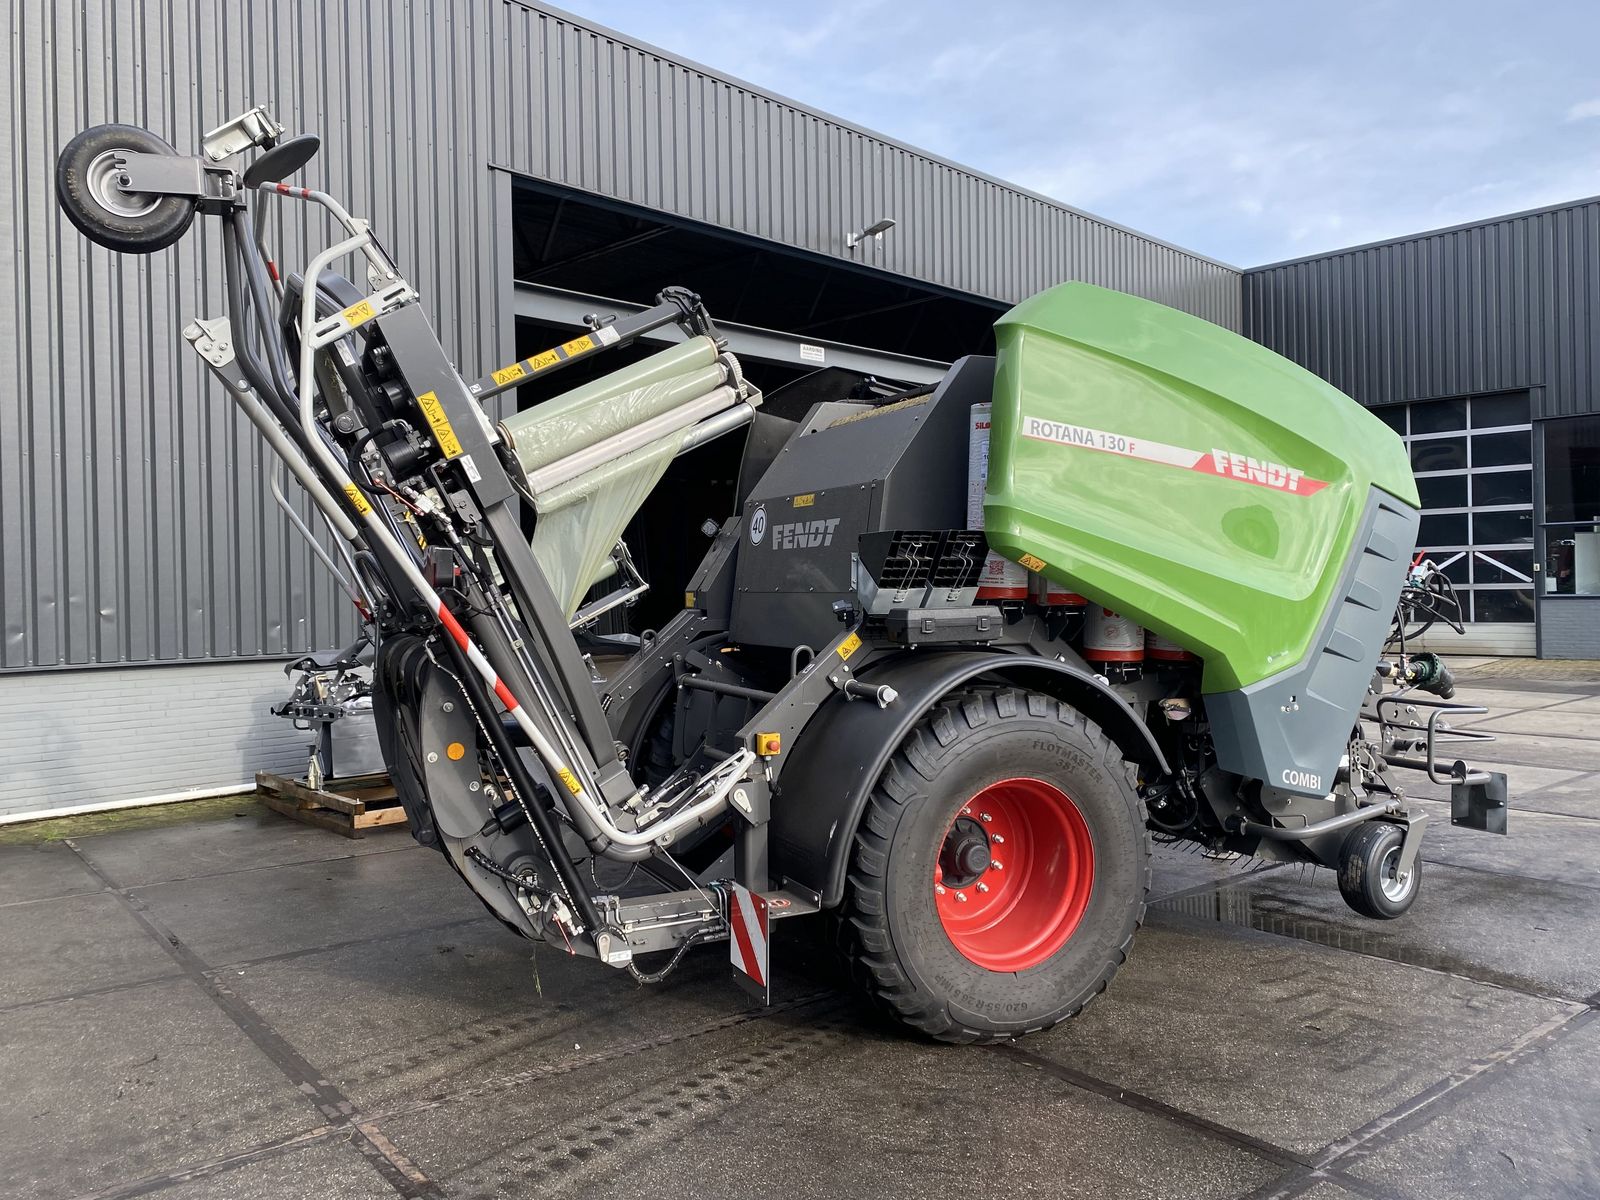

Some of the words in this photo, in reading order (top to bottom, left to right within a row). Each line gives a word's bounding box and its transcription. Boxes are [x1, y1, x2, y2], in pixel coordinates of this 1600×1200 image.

[1030, 420, 1095, 447] ROTANA
[1099, 434, 1126, 452] 130
[1129, 442, 1135, 454] F
[1211, 448, 1304, 491] FENDT
[752, 516, 764, 534] 40
[772, 517, 840, 550] FENDT
[1032, 740, 1103, 784] FLOTMASTER
[1055, 758, 1076, 774] 381
[1282, 769, 1321, 790] COMBI
